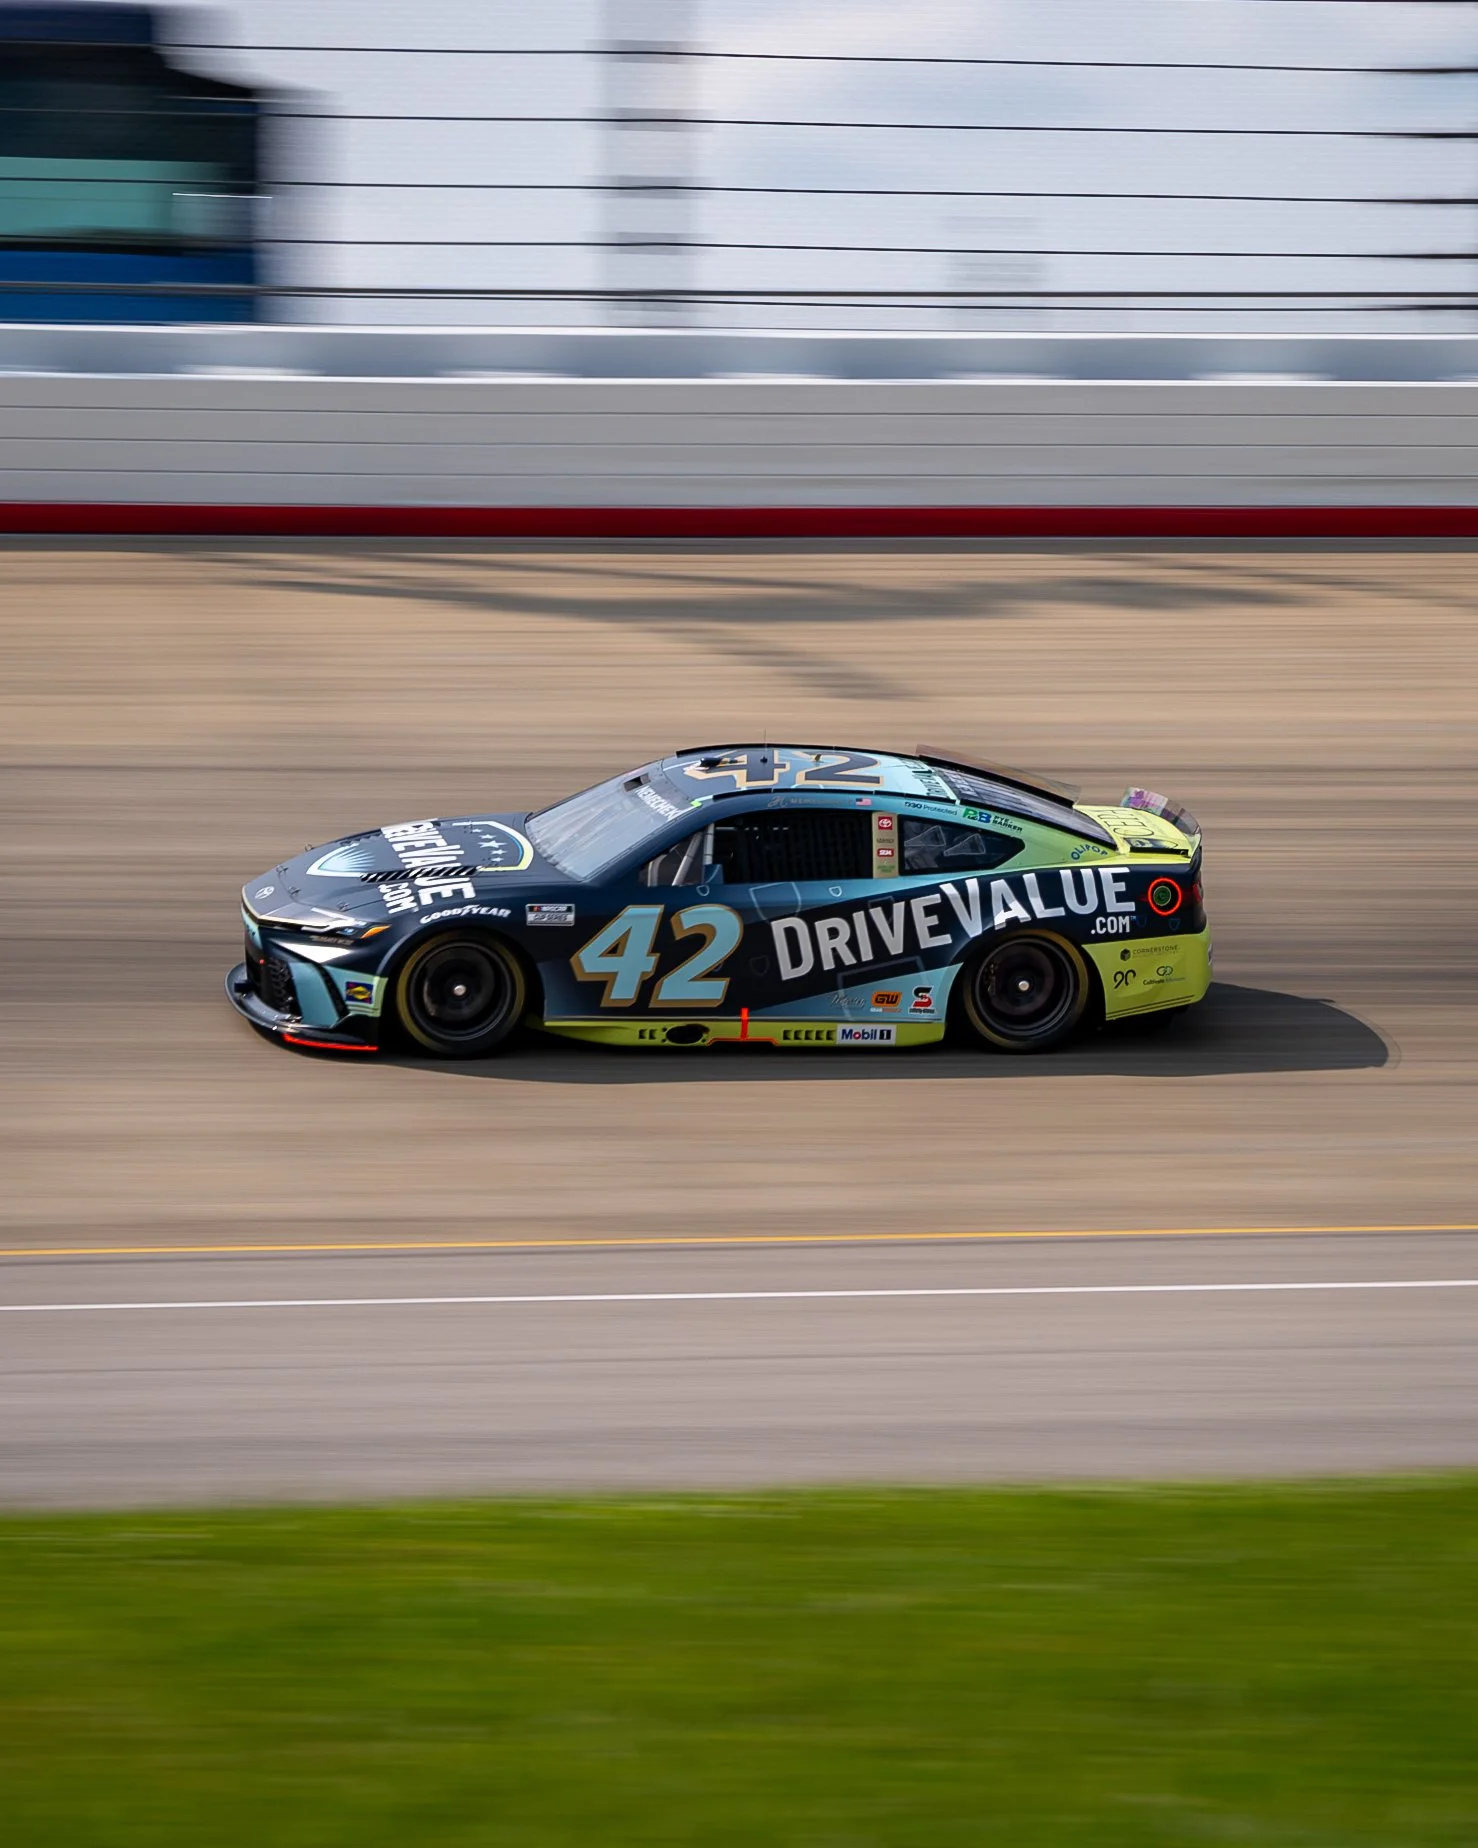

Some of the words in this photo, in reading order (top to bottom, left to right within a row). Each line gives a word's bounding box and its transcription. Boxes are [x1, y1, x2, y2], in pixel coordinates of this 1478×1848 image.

[683, 749, 884, 788] 42
[419, 903, 513, 925] GOODYEAR
[771, 867, 1136, 981] DRIVEVALUE
[569, 904, 744, 1009] 42
[1132, 944, 1178, 955] CORNERSTONE
[875, 993, 899, 1005] GW
[841, 1028, 877, 1040] Mobil
